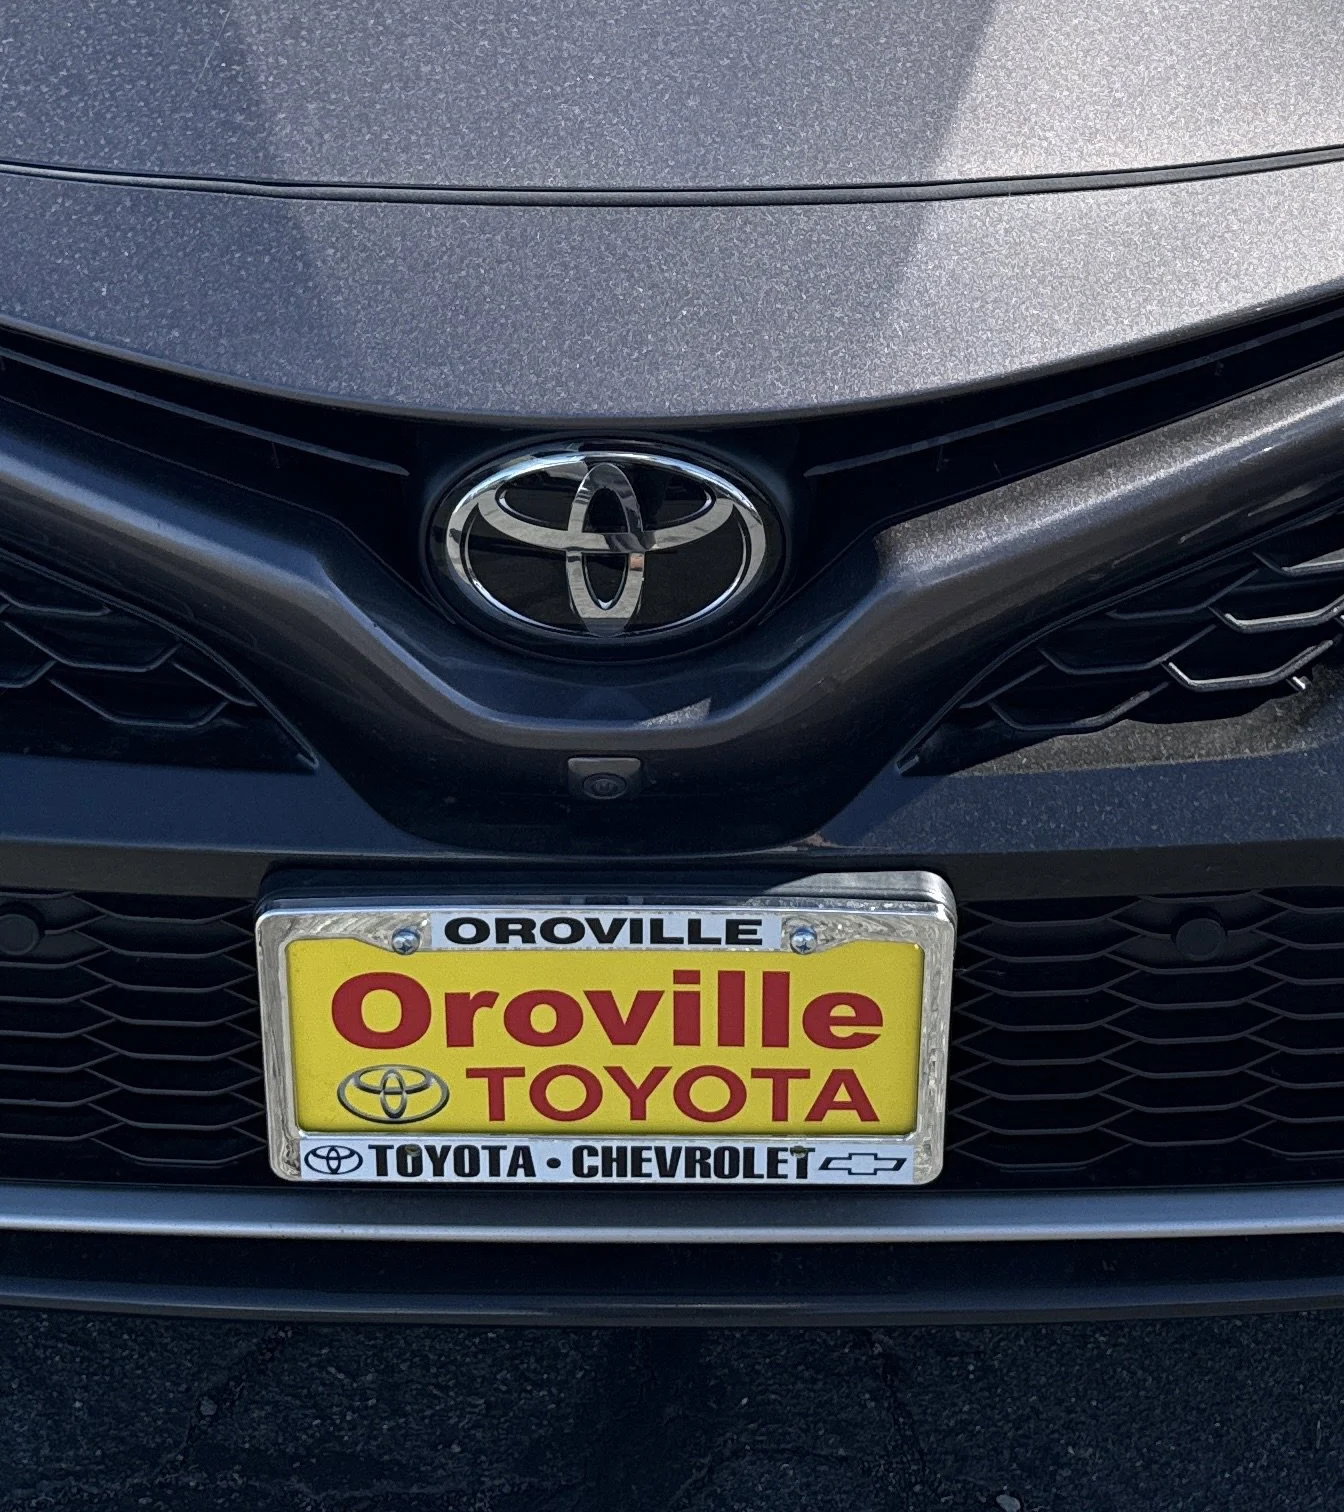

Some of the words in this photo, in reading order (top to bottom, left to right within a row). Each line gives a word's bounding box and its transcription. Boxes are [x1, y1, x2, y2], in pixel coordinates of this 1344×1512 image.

[444, 916, 763, 946] OROVILLE
[331, 970, 884, 1050] Oroville
[465, 1064, 880, 1123] TOYOTA
[367, 1143, 537, 1179] TOYOTA
[571, 1144, 816, 1180] CHEVROLET
